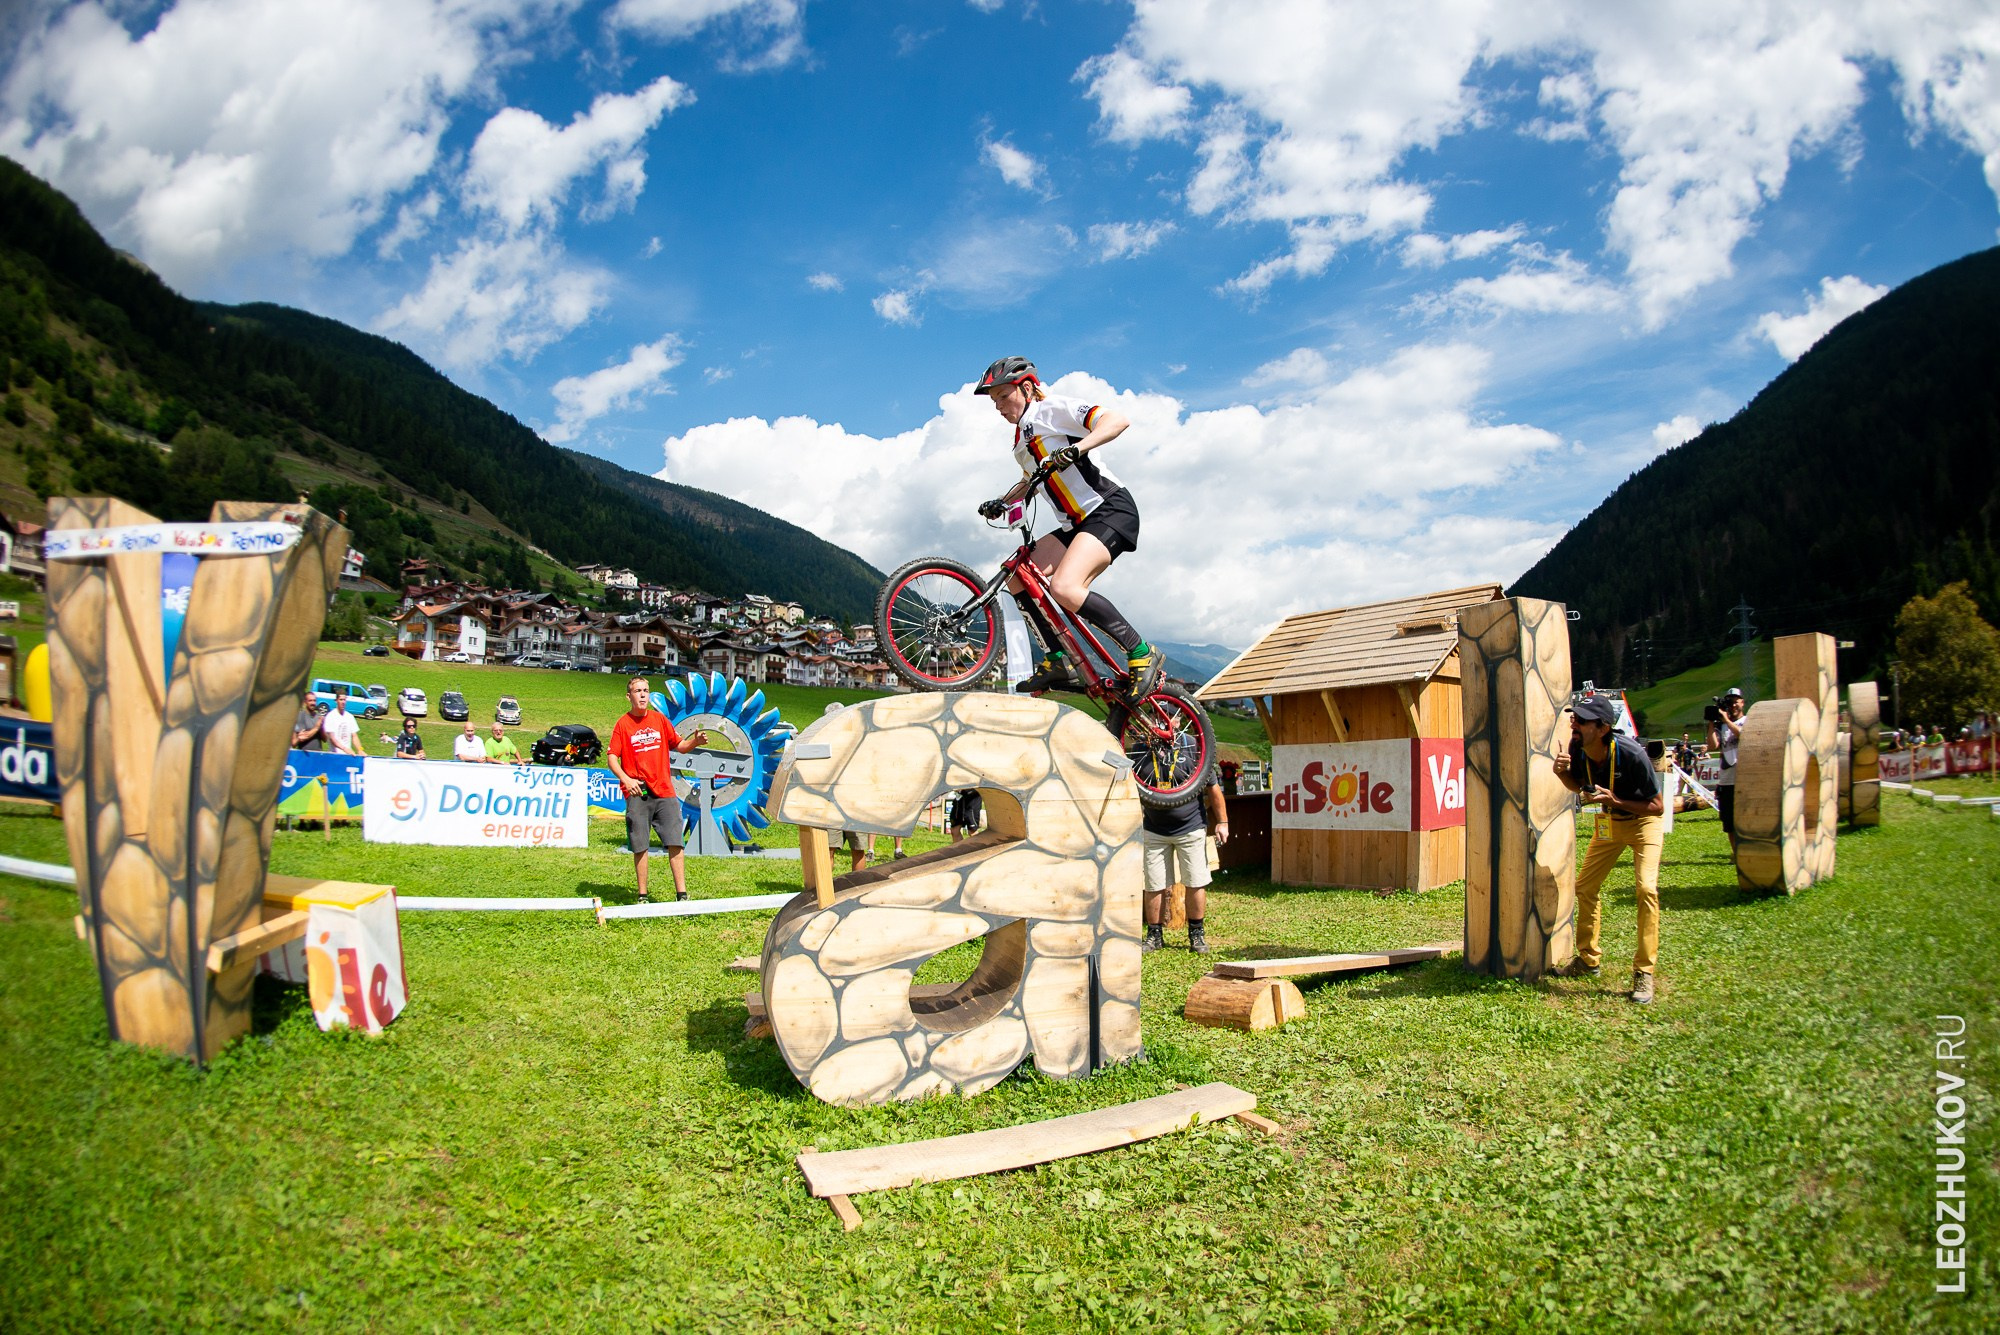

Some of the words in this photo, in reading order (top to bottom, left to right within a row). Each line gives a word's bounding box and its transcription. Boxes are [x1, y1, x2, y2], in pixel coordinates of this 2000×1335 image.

[231, 531, 284, 550] TRENTINO
[1694, 763, 1712, 782] Val
[439, 783, 571, 819] Dolomiti
[482, 822, 565, 845] energia
